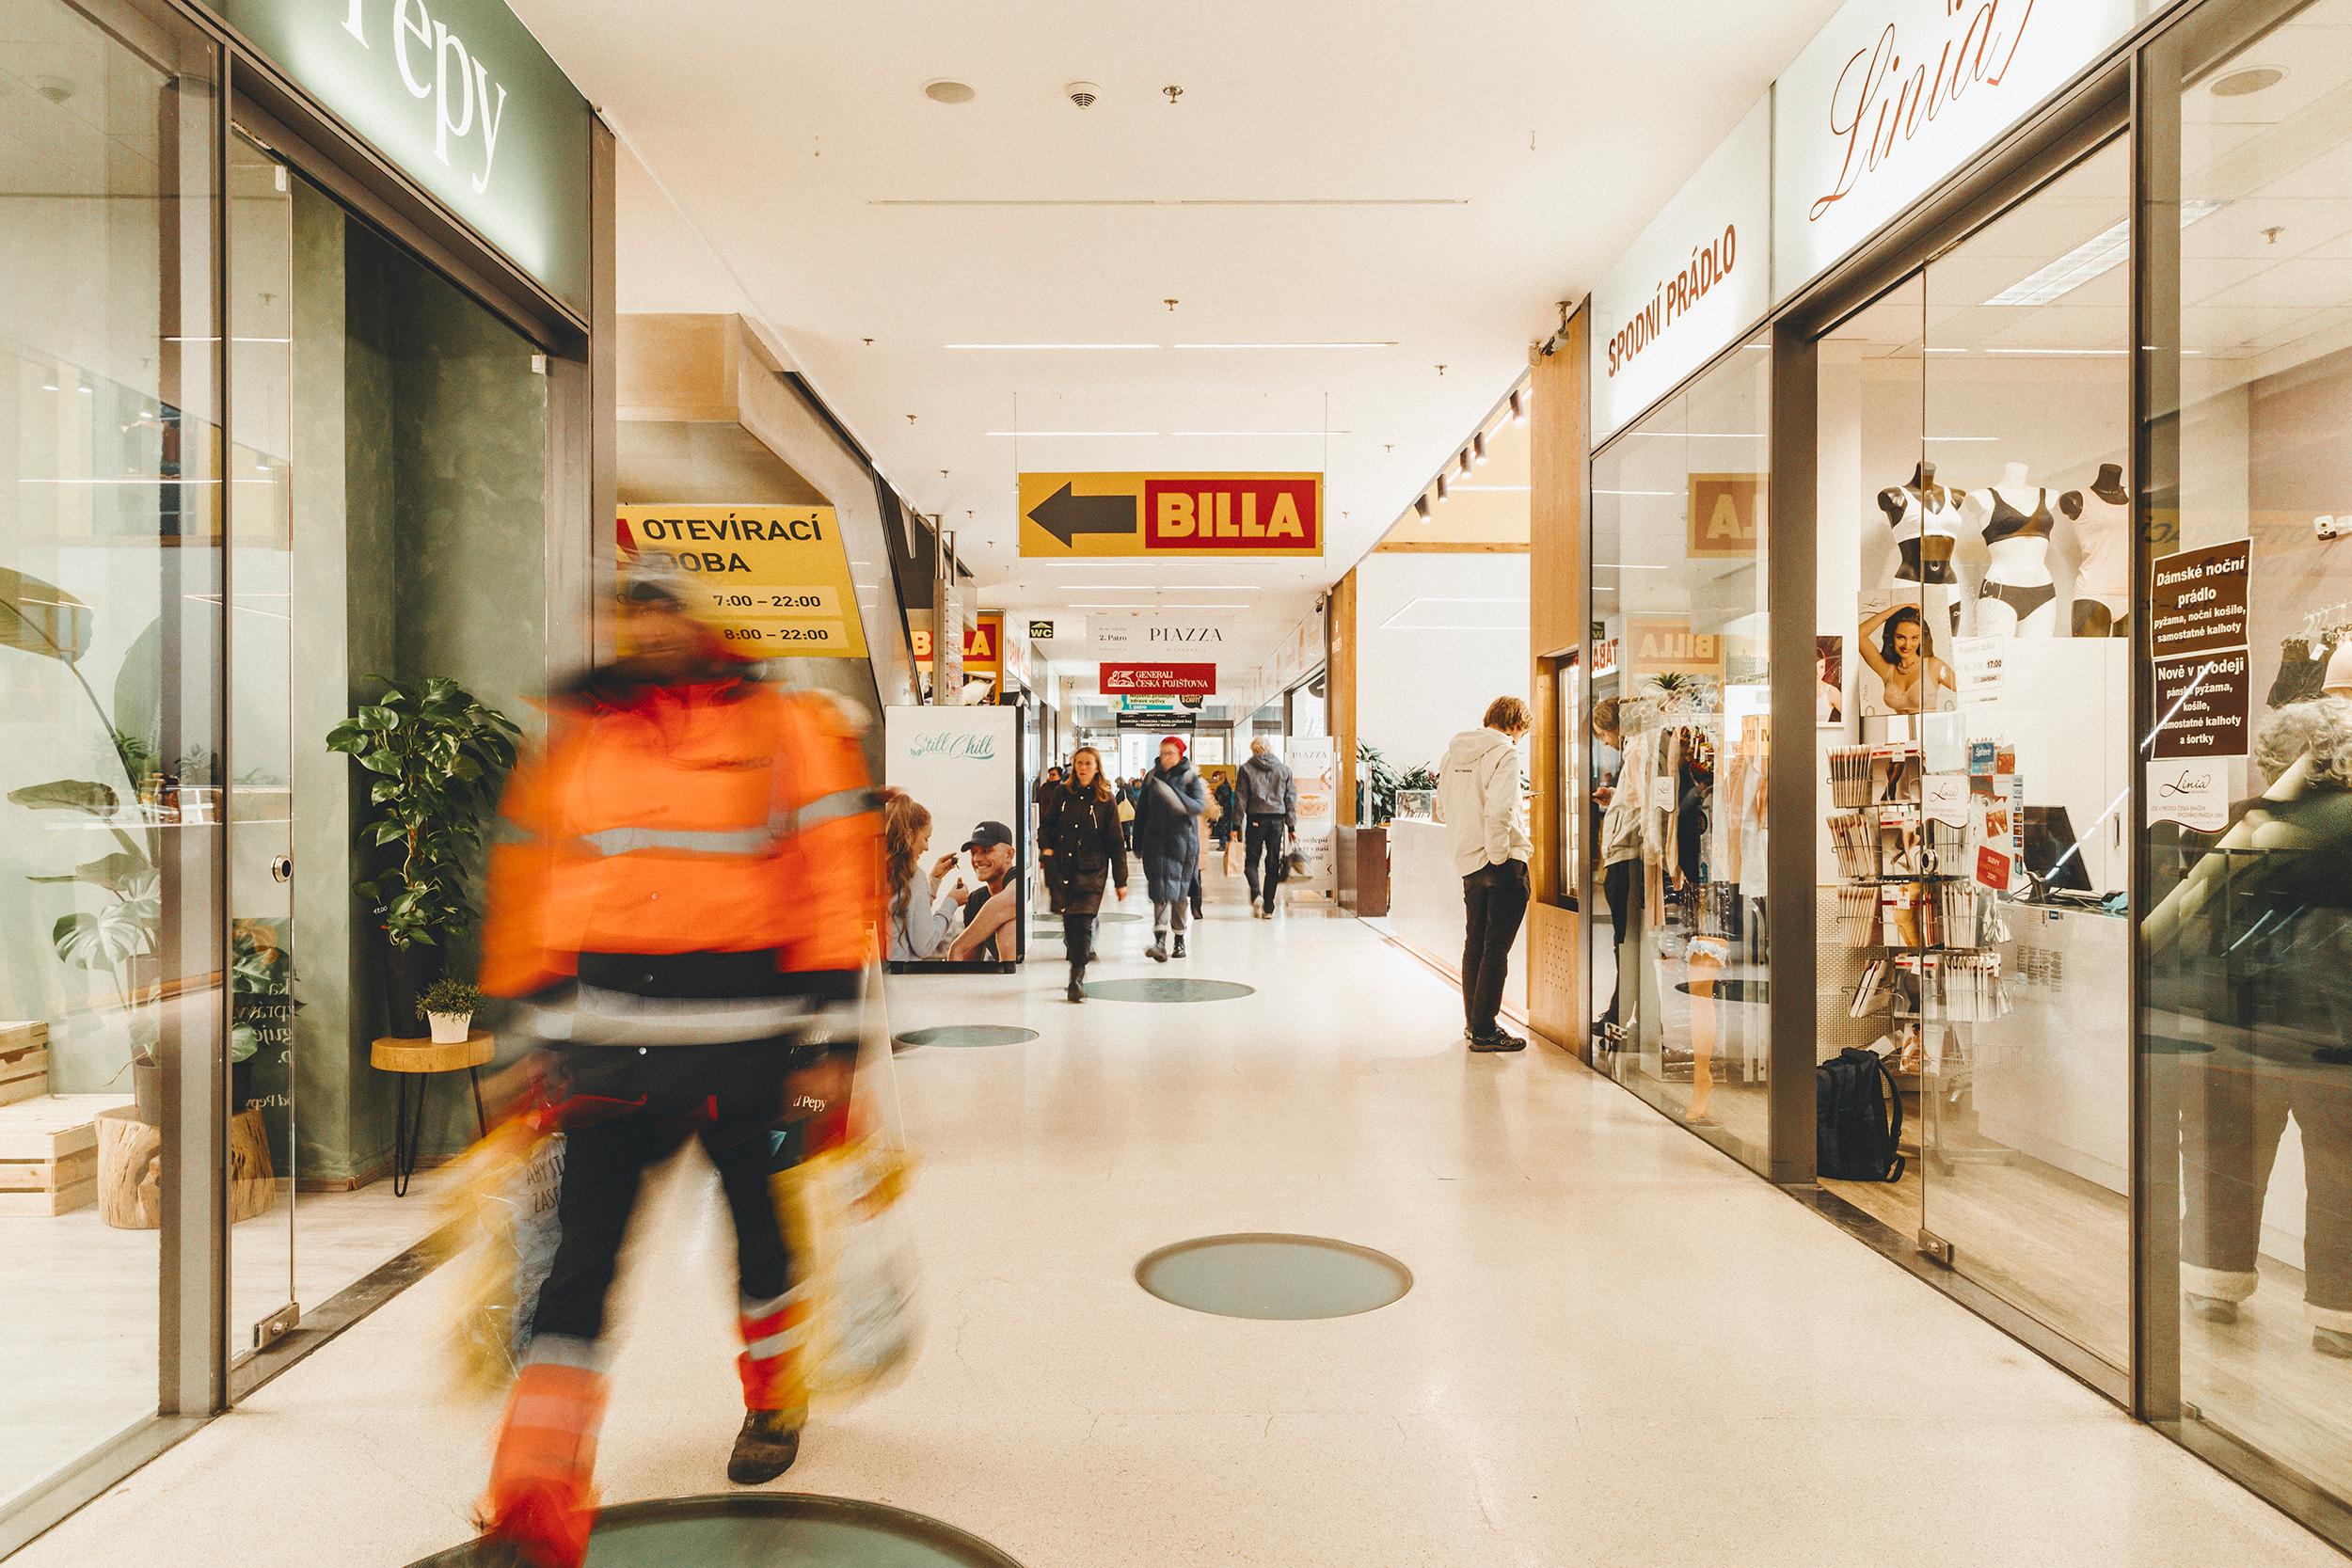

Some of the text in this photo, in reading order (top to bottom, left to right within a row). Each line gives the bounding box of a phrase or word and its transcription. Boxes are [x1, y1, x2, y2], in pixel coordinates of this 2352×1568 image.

[1608, 224, 1736, 378] SPODNÍ PRÁDLO
[1157, 492, 1305, 538] BILLA
[642, 513, 823, 541] OTEVÍRACÍ
[2156, 555, 2246, 587] Dámské noční
[771, 595, 821, 607] 22:00
[2178, 587, 2217, 609] prádlo
[2153, 604, 2247, 629] pyžama, noční košile,
[723, 628, 762, 641] 8:00
[781, 629, 829, 641] 22:00
[1029, 628, 1053, 638] WC
[1150, 627, 1223, 641] PIAZZA
[2156, 621, 2242, 643] samostatné kalhoty
[1987, 659, 2002, 669] 17:00
[2157, 657, 2244, 681] Nově v podeji
[1135, 671, 1174, 679] GENERALI
[1135, 678, 1209, 689] ČESKÁ POJIŠŤOVNA
[2195, 683, 2233, 696] pyžama,
[2183, 700, 2210, 712] košile,
[2205, 714, 2242, 727] kalhoty
[913, 732, 995, 760] Still Chill
[2186, 734, 2215, 745] šortky
[2159, 769, 2211, 798] Linia
[803, 1095, 828, 1113] Pepy
[527, 1161, 548, 1186] ABY
